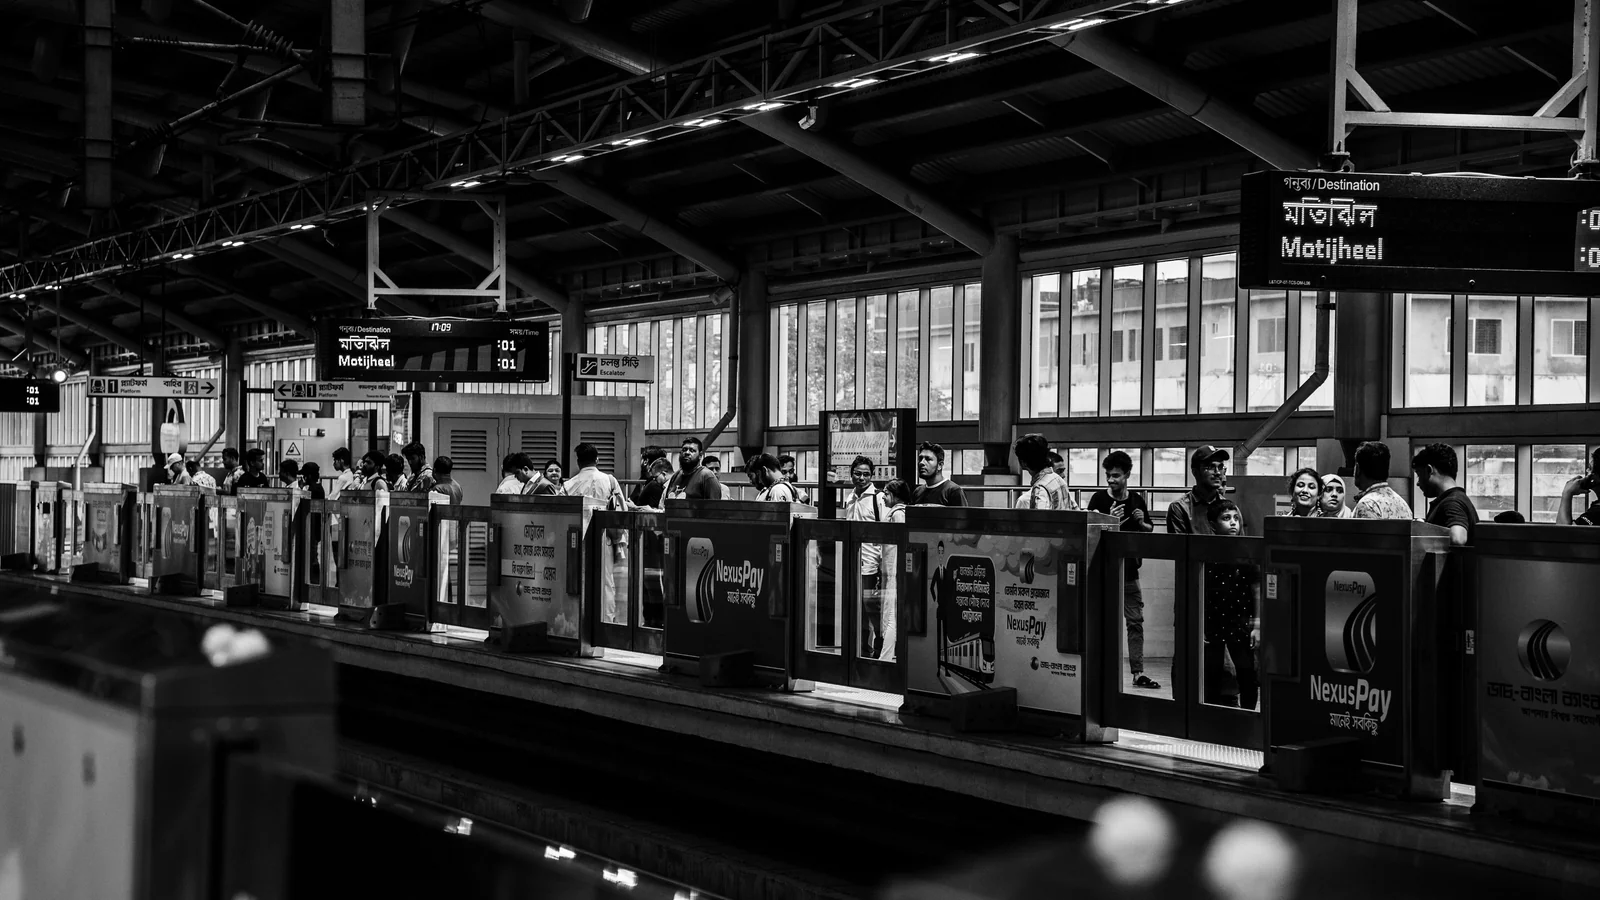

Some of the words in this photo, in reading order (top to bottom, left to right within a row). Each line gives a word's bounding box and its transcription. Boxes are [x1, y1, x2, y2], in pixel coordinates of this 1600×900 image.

[1283, 197, 1378, 228] মতিঝিল
[1282, 236, 1383, 264] Motijheel
[431, 322, 452, 332] 17:09
[338, 335, 390, 351] মতিঝিল
[497, 340, 516, 351] :01
[338, 355, 394, 369] Motijheel
[497, 358, 516, 370] :01
[600, 358, 620, 368] চলন্ত
[26, 386, 39, 394] :01
[26, 397, 39, 405] :01
[691, 546, 709, 559] NexusPay
[716, 559, 764, 597] NexusPay
[1333, 580, 1366, 598] NexusPay
[1006, 614, 1046, 641] NexusPay
[1310, 674, 1392, 722] NexusPay
[1329, 711, 1351, 730] মানেই
